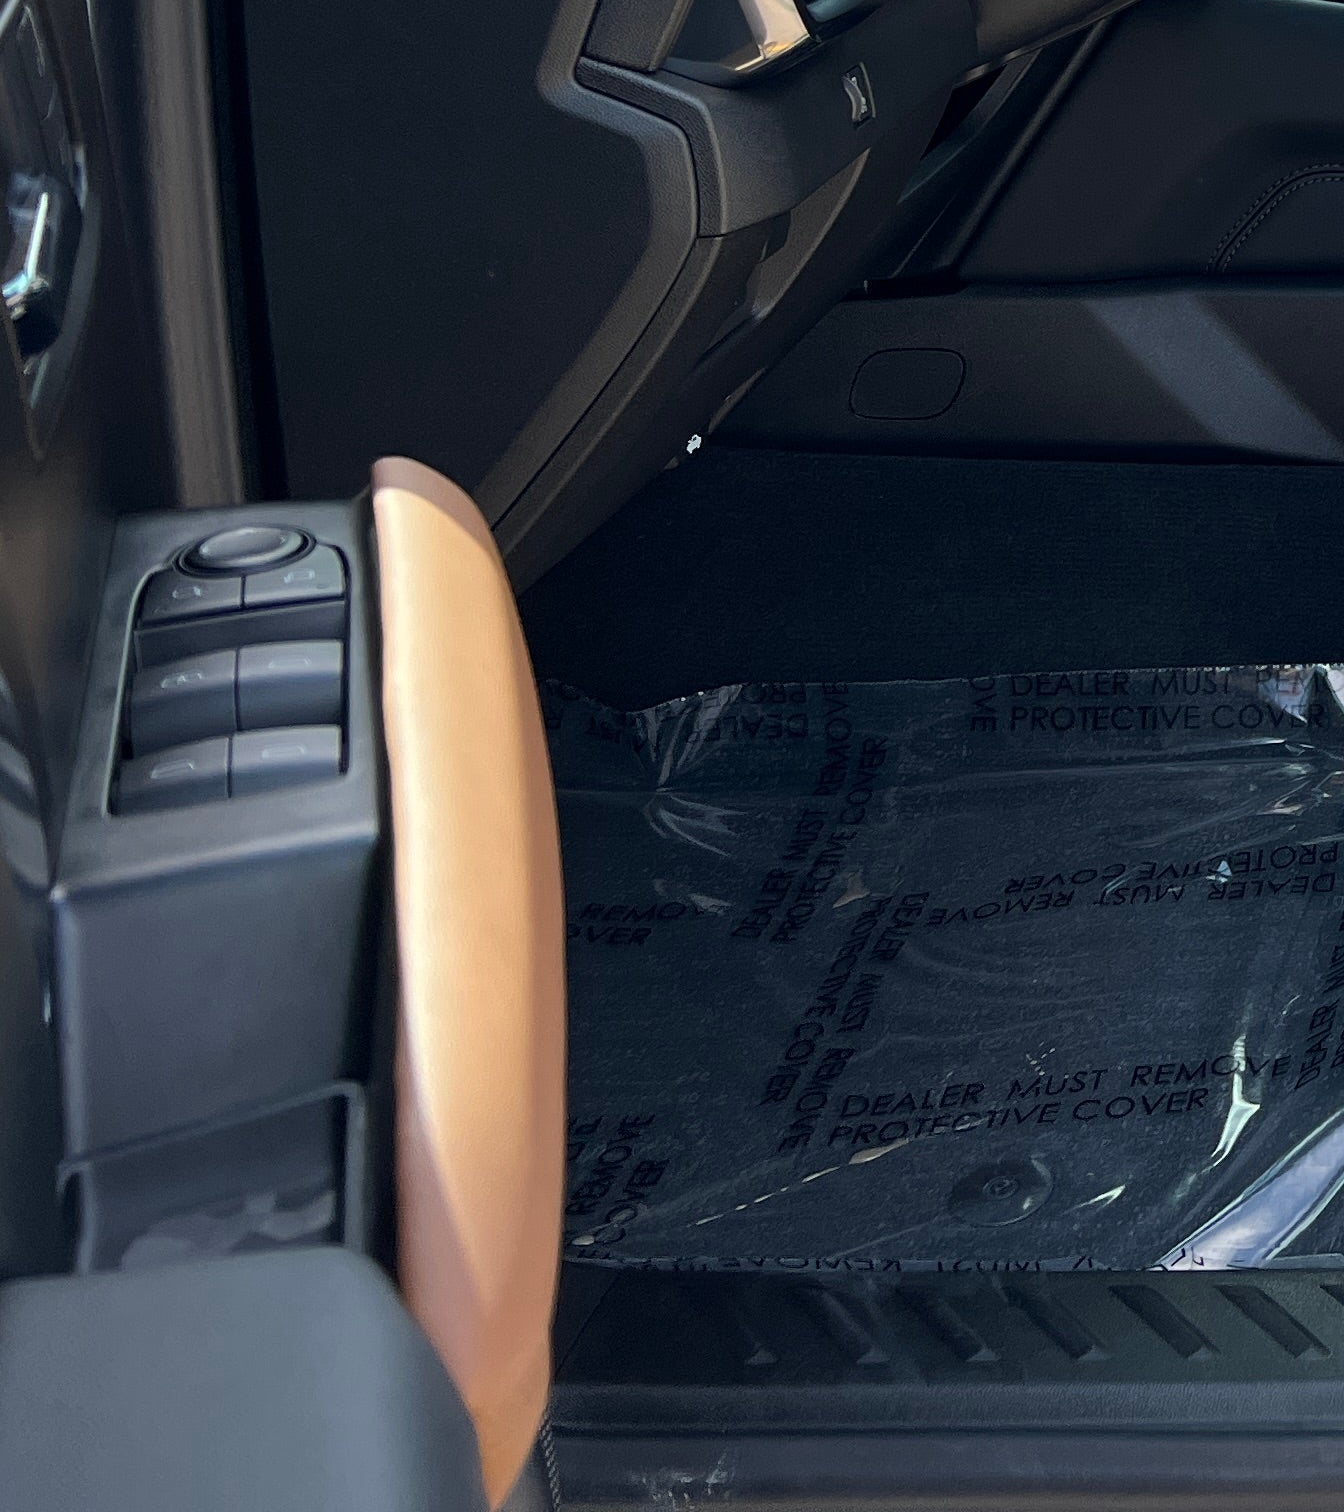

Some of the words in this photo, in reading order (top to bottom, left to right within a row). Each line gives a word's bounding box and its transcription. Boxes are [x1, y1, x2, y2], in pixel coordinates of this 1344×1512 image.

[1010, 671, 1129, 697] DEALER
[1152, 668, 1230, 696] MUST
[1010, 704, 1200, 732] PROTECTIVE
[1211, 702, 1327, 731] COVER
[838, 737, 888, 826] COVER
[1004, 863, 1128, 895] COVER
[1138, 841, 1338, 883] PROTECTIVE
[1094, 885, 1185, 907] MUST
[1208, 872, 1336, 901] DEALER
[926, 890, 1073, 927] REMOVE
[1294, 998, 1339, 1090] DEALER
[840, 1083, 986, 1118] DEALER
[1007, 1070, 1108, 1100] MUST
[1130, 1054, 1291, 1088] REMOVE
[827, 1103, 1058, 1147] PROTECTIVE
[1072, 1087, 1210, 1123] COVER
